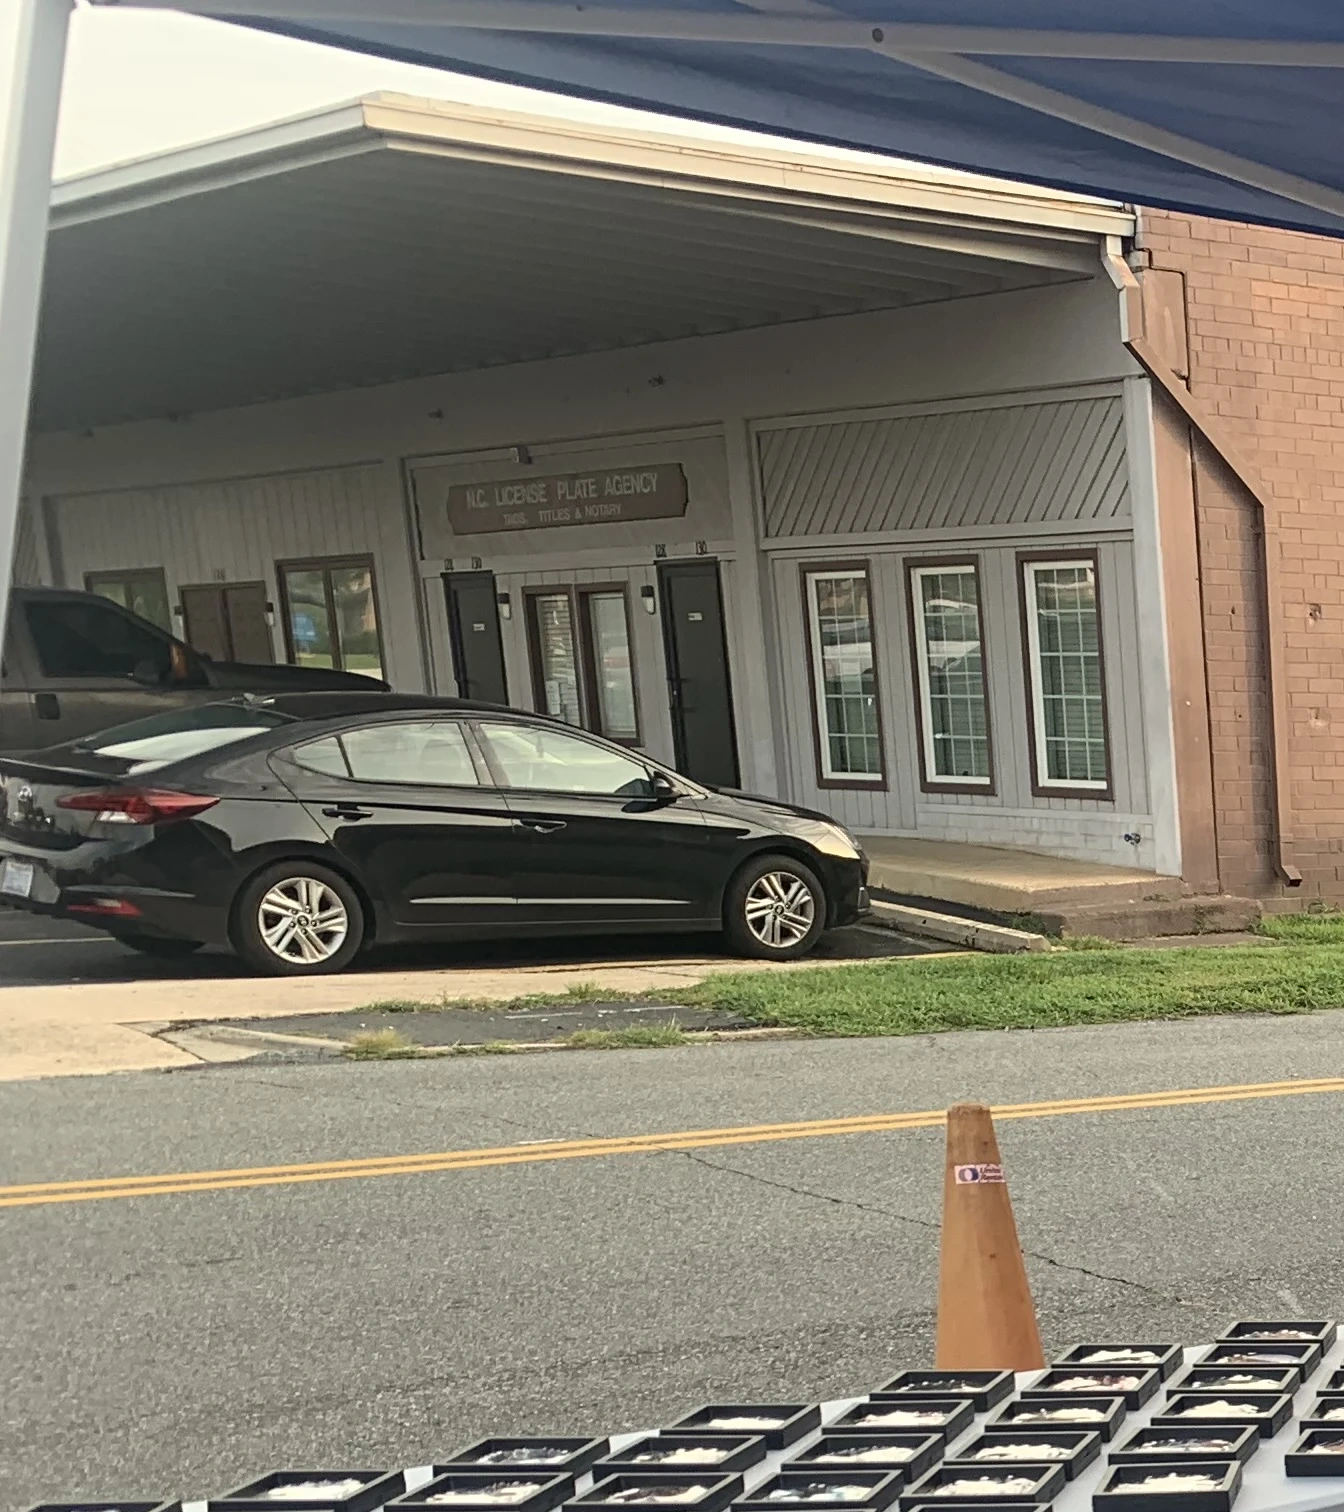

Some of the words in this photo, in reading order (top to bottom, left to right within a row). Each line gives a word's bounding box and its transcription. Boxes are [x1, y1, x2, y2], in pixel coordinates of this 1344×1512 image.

[494, 483, 548, 507] LICENSE
[557, 478, 598, 501] PLATE
[604, 472, 658, 497] AGENCY
[537, 506, 571, 523] TITLES
[574, 506, 583, 520] &
[585, 503, 621, 518] NOTARY
